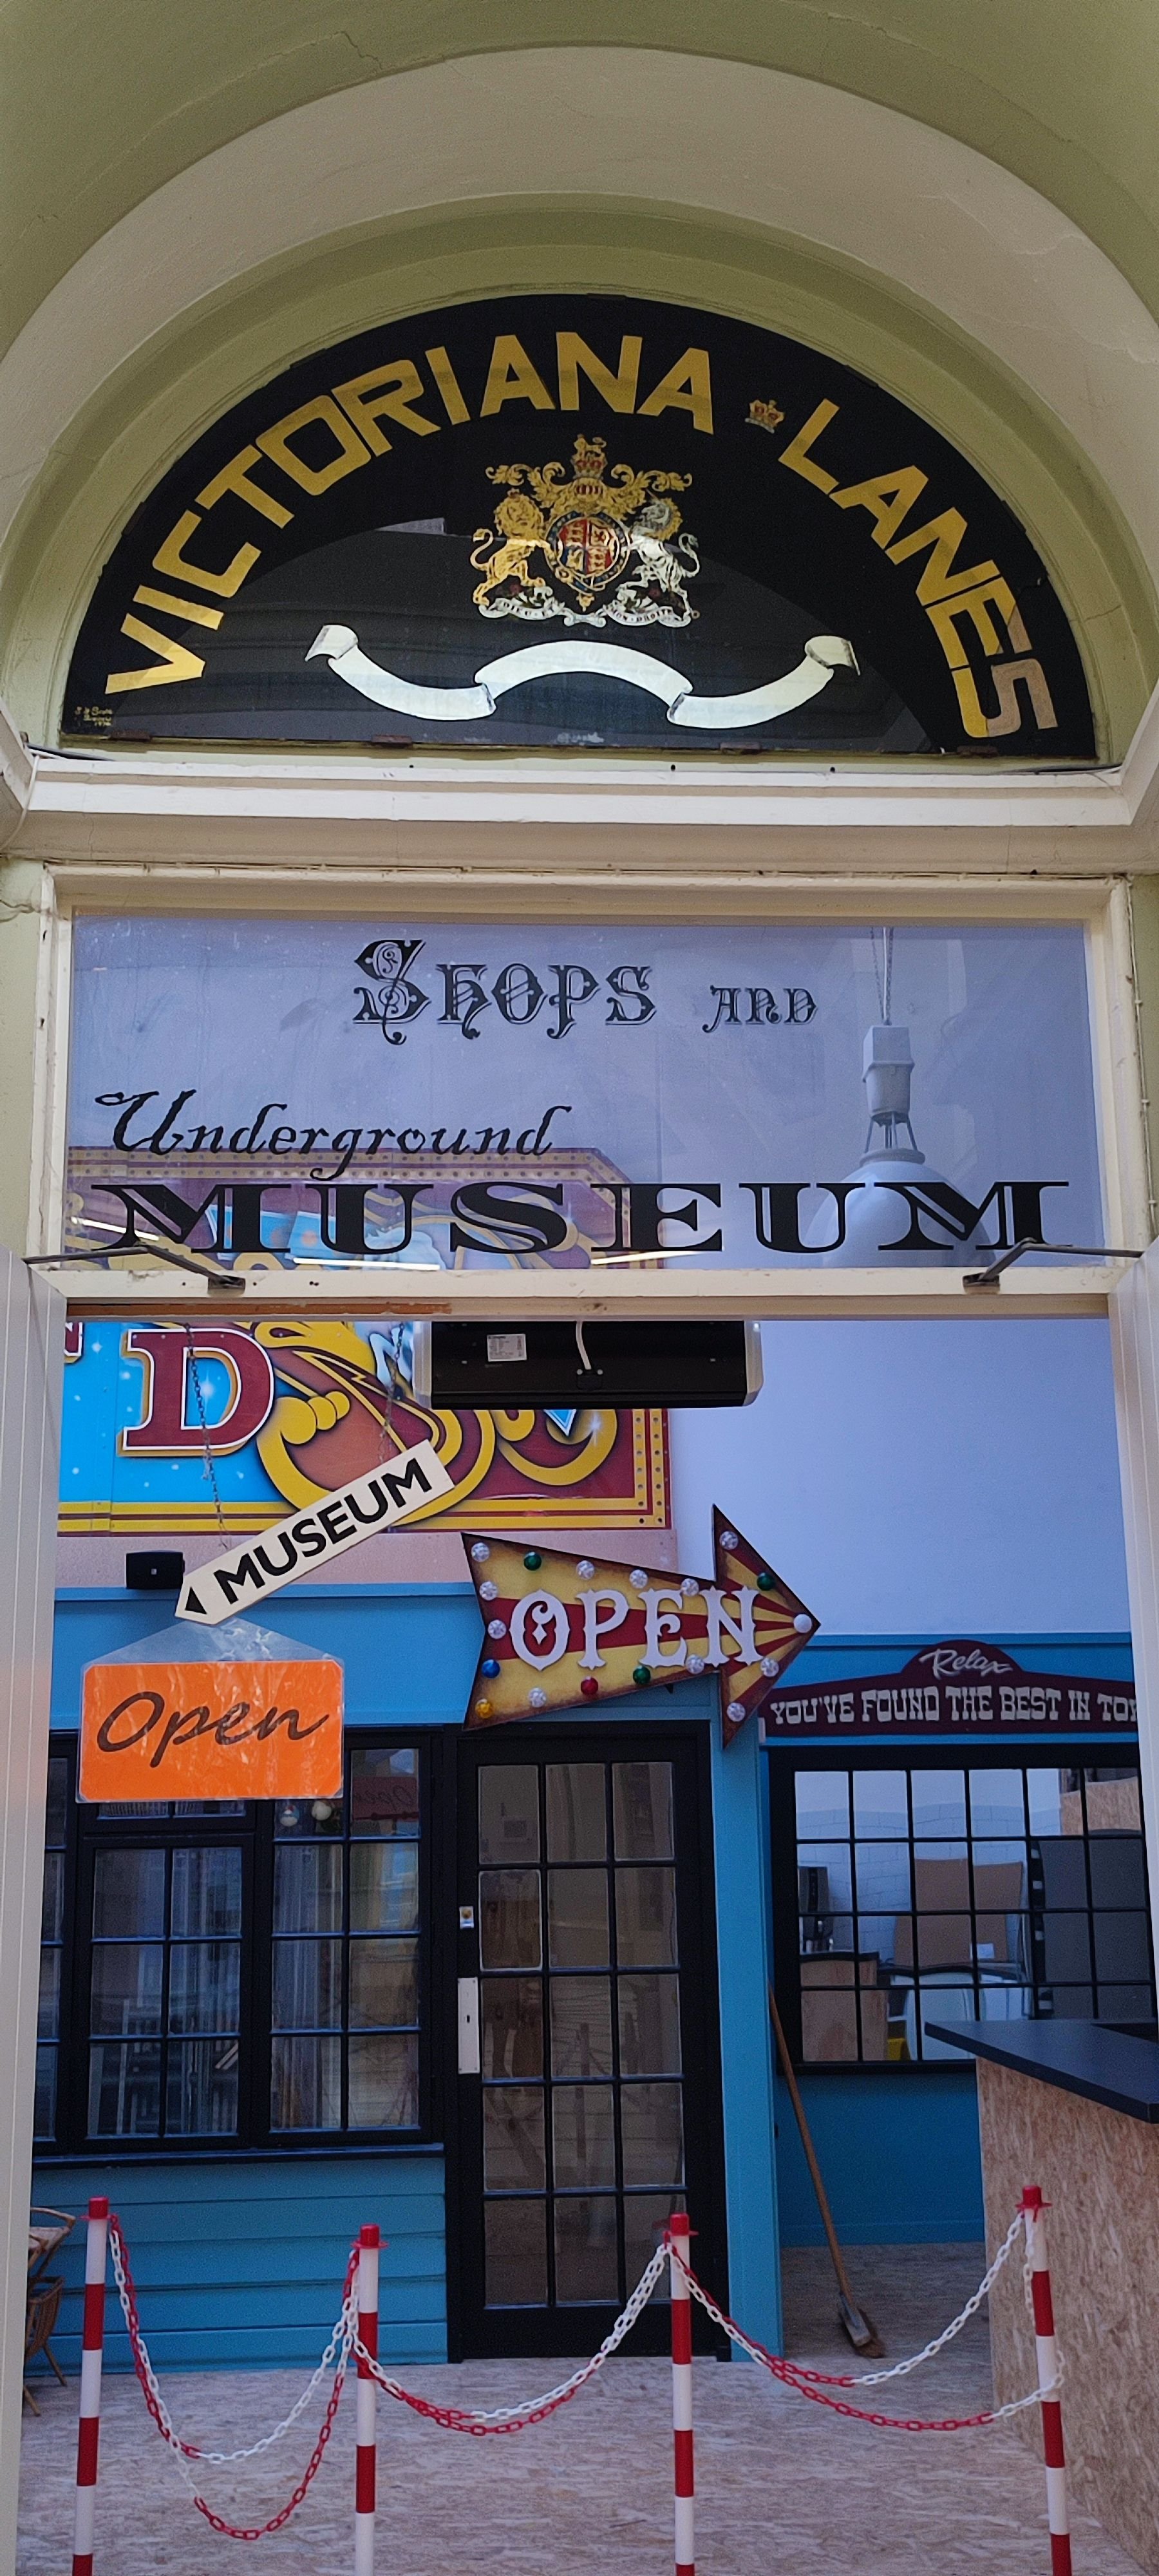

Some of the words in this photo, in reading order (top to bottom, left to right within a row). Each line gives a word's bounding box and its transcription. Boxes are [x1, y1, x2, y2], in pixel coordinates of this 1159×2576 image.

[105, 331, 715, 695] VICTORIANA
[778, 397, 1058, 738] LANES
[94, 1088, 572, 1180] Underground
[91, 1180, 1072, 1255] MUSEUM
[214, 1457, 433, 1604] MUSEUM
[509, 1586, 765, 1671] OPEN
[919, 1648, 1013, 1680] Relax
[97, 1690, 330, 1768] Open
[770, 1692, 854, 1725] YOU'VE
[861, 1686, 940, 1722] FOUND
[945, 1685, 994, 1721] THE
[999, 1685, 1062, 1721] BEST
[1068, 1689, 1091, 1721] IN
